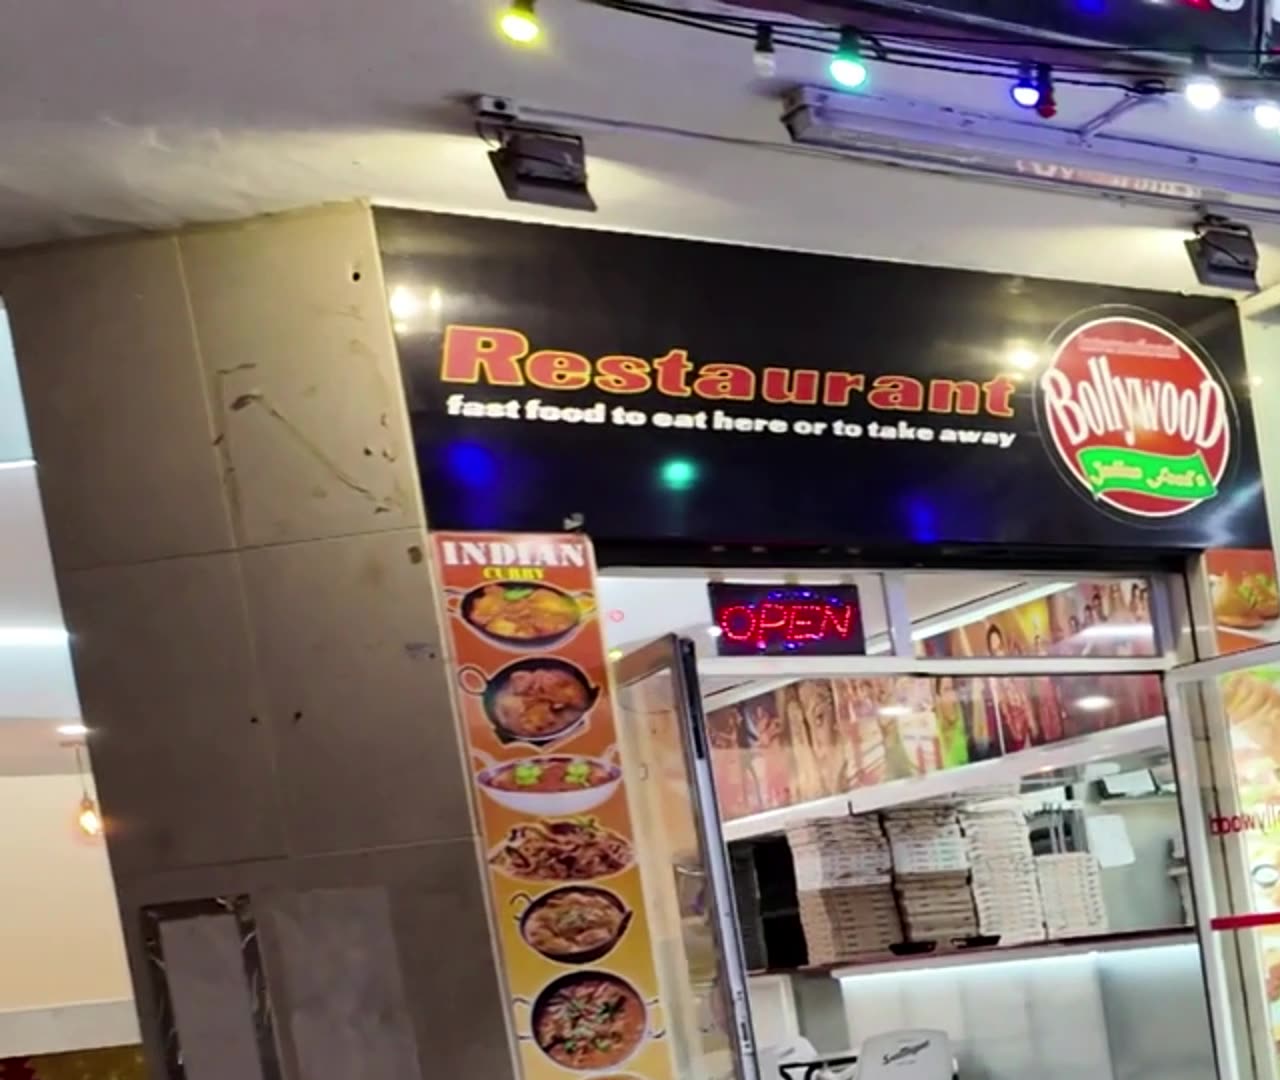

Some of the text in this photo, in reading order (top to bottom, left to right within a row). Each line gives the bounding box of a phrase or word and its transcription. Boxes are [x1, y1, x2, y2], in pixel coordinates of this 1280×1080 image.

[441, 324, 1015, 417] Restaurant
[446, 394, 1017, 449] fast food to eat here or to take away
[441, 541, 586, 567] INDIAN
[482, 566, 545, 580] CURRY
[721, 603, 852, 641] OPEN
